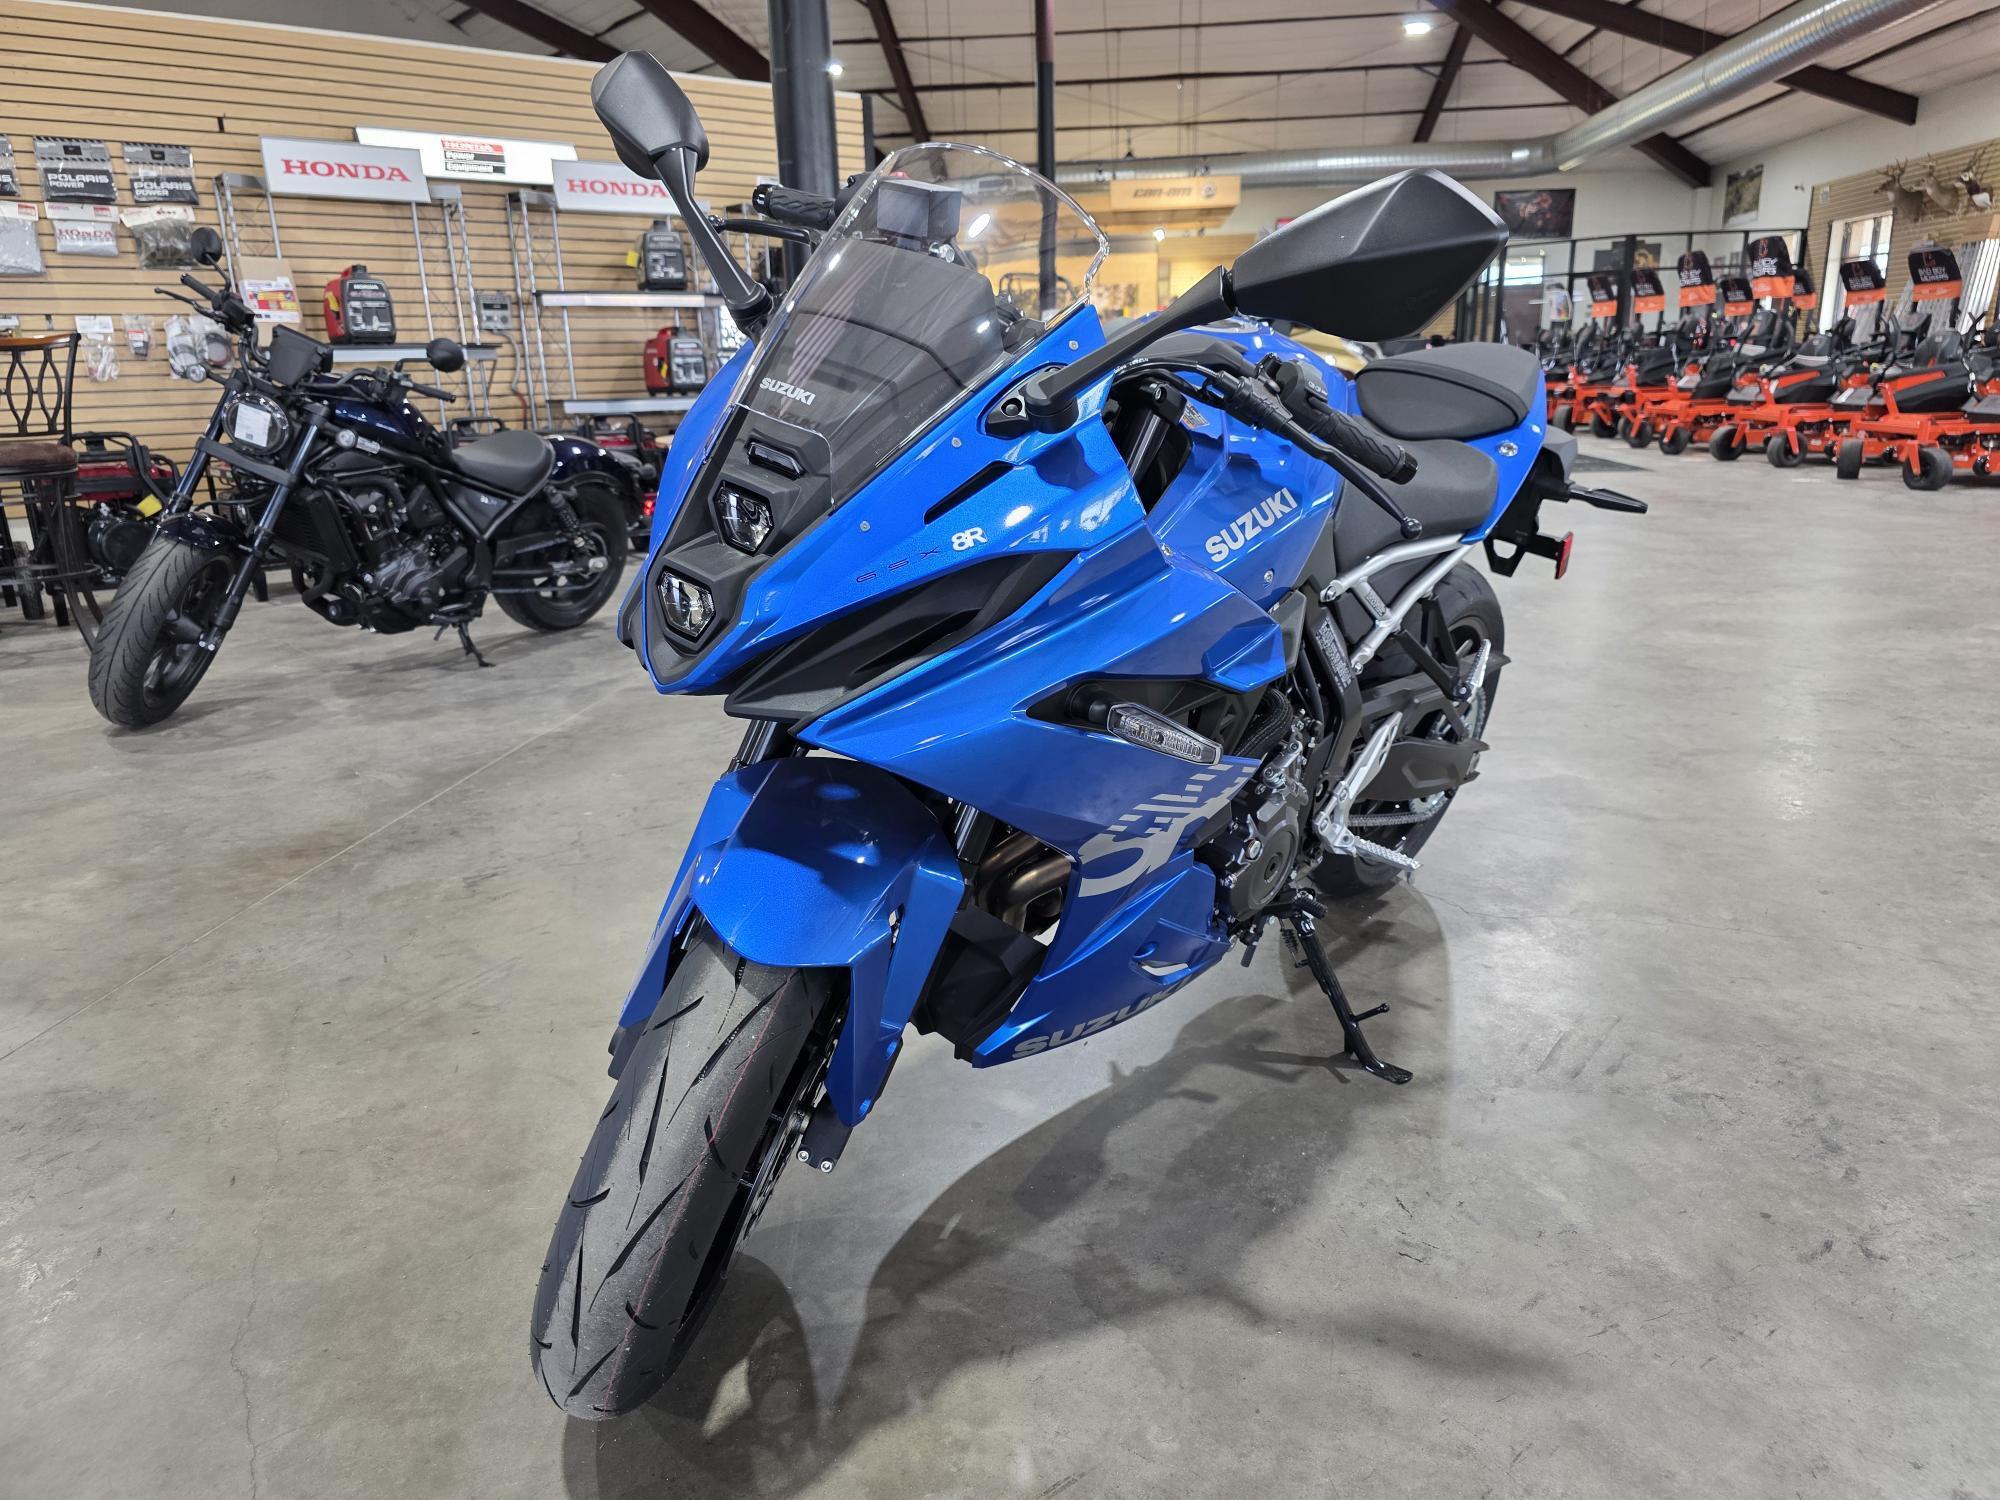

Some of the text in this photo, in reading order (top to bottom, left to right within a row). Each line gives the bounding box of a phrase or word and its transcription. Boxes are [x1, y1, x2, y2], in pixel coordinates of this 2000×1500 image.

[47, 172, 110, 184] POLARIS
[281, 158, 412, 183] HONDA
[49, 181, 85, 190] POWER
[133, 181, 193, 191] POLARIS
[135, 188, 170, 197] POWER
[567, 178, 669, 199] HONDA
[759, 377, 816, 406] SUZUKI
[1205, 487, 1298, 562] SUZUKI
[951, 526, 988, 551] 8R
